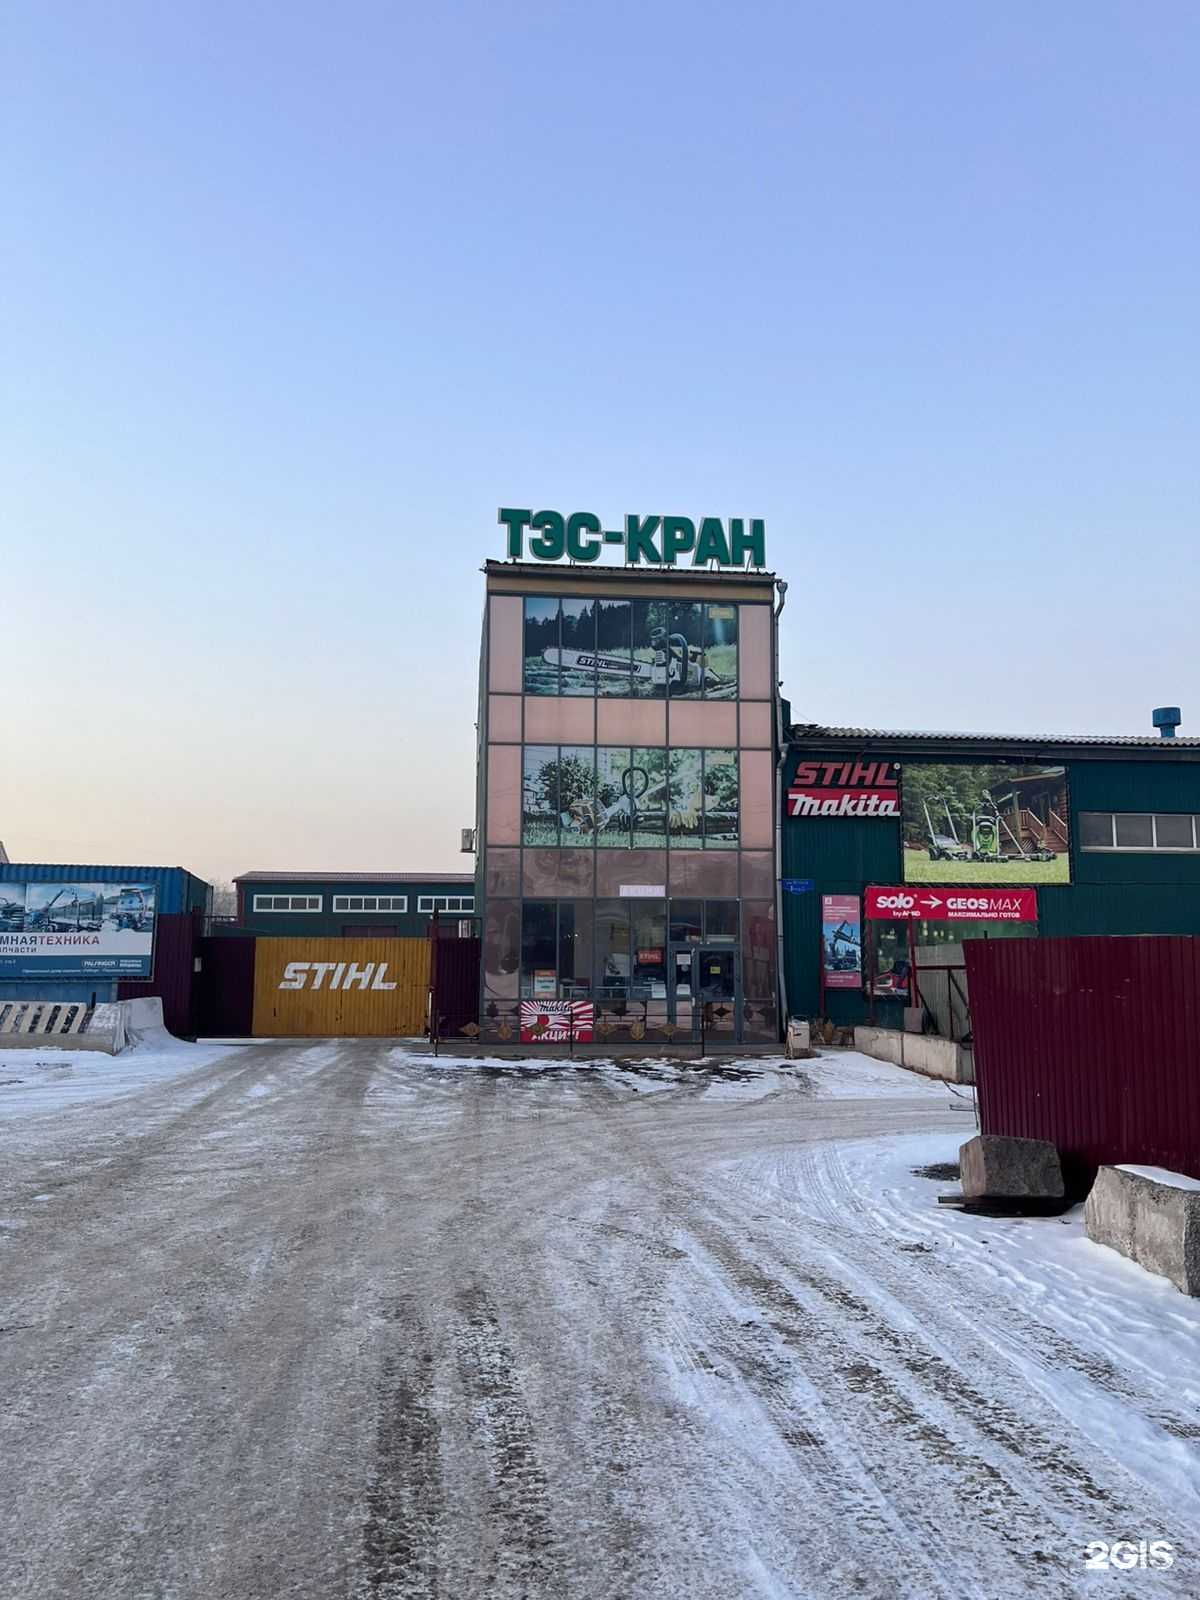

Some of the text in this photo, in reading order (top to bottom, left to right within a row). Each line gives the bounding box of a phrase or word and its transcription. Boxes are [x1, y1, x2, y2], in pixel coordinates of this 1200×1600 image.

[498, 507, 766, 568] ТЭС-КРАН
[793, 761, 897, 786] STIHL
[876, 893, 1022, 911] solo GEOSMAX
[278, 962, 398, 990] STIHL
